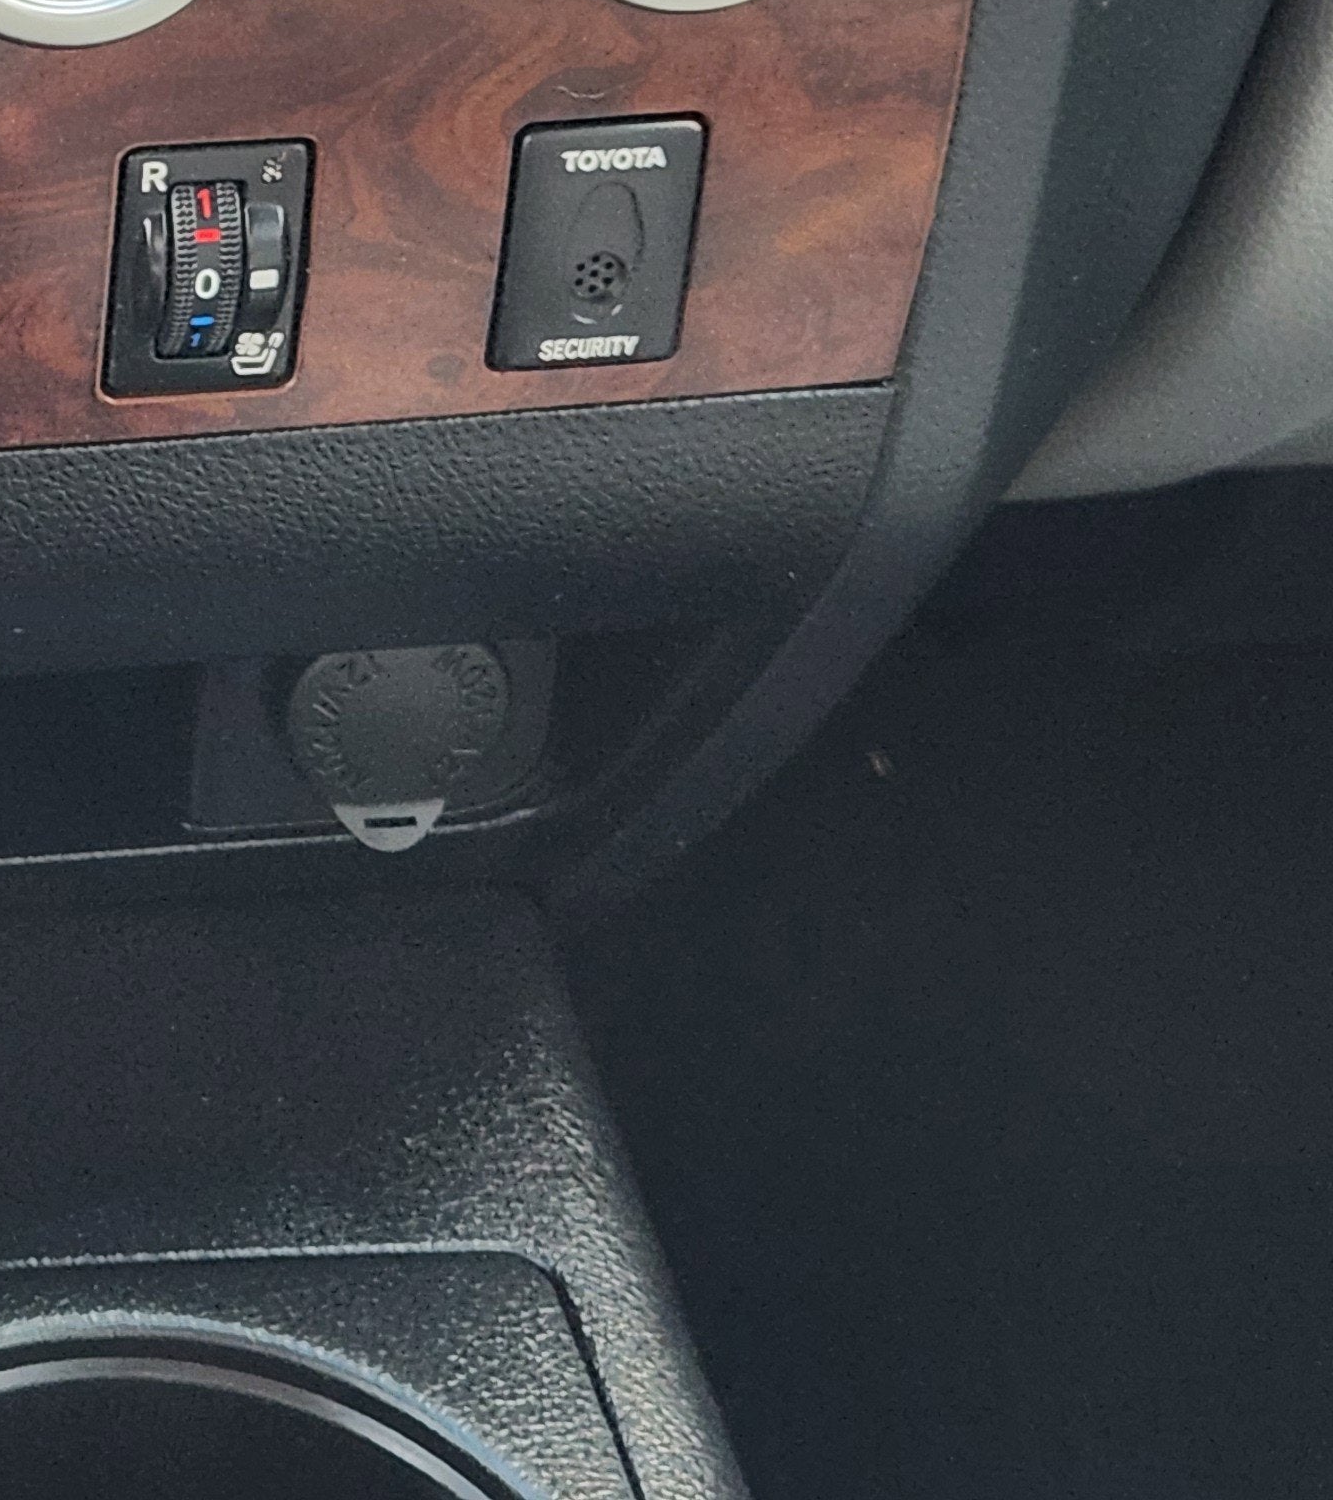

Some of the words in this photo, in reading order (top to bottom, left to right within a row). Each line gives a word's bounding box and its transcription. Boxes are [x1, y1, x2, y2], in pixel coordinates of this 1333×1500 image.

[560, 145, 668, 172] TOYOTA
[140, 160, 169, 194] R
[196, 187, 212, 220] 1
[193, 267, 221, 300] 0
[538, 334, 640, 361] SECURITY
